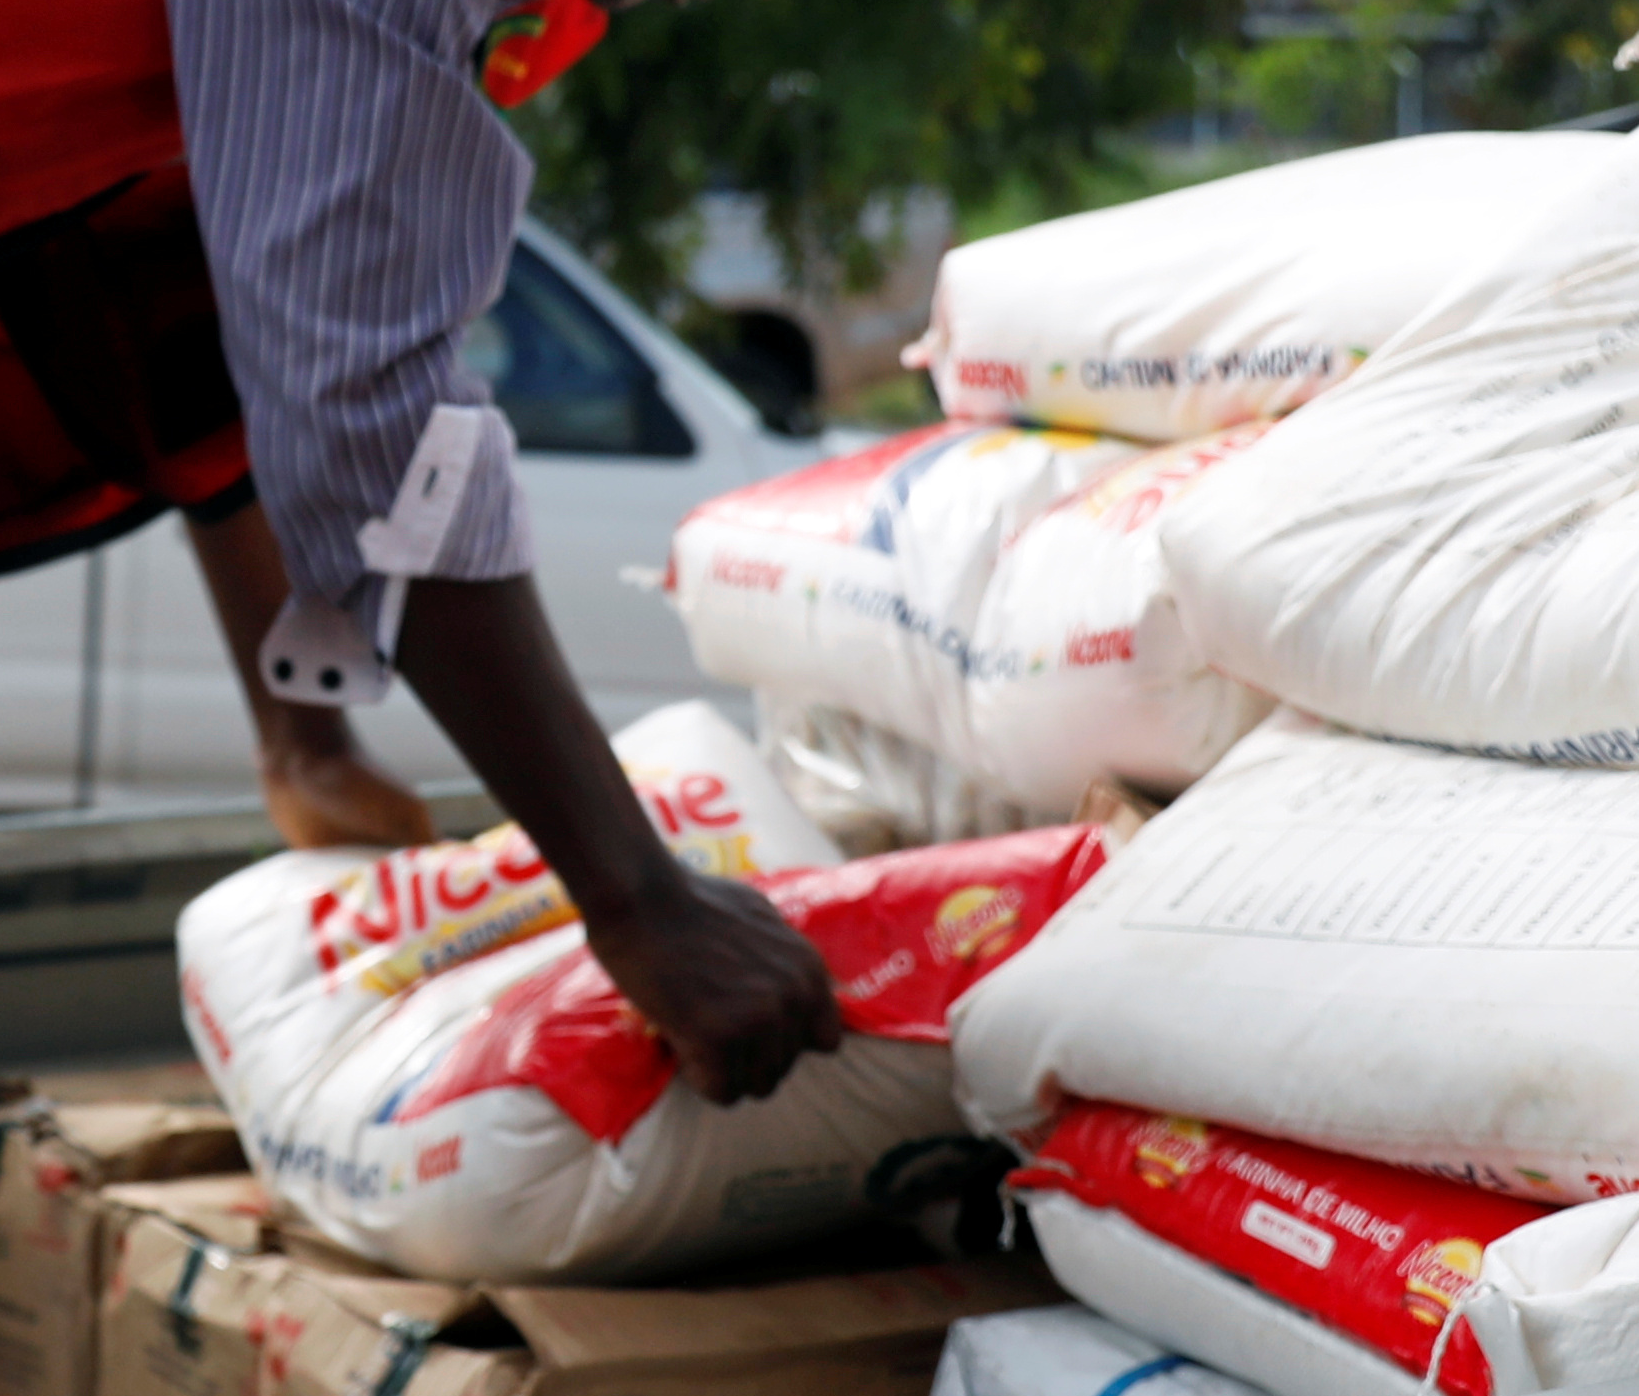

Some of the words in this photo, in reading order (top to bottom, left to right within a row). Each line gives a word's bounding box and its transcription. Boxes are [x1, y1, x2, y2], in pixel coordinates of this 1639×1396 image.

[1216, 1147, 1307, 1205] FARINHA
[1303, 1183, 1338, 1217] DE
[1330, 1193, 1407, 1253] MILHO
[1396, 1239, 1481, 1309] Niceon
